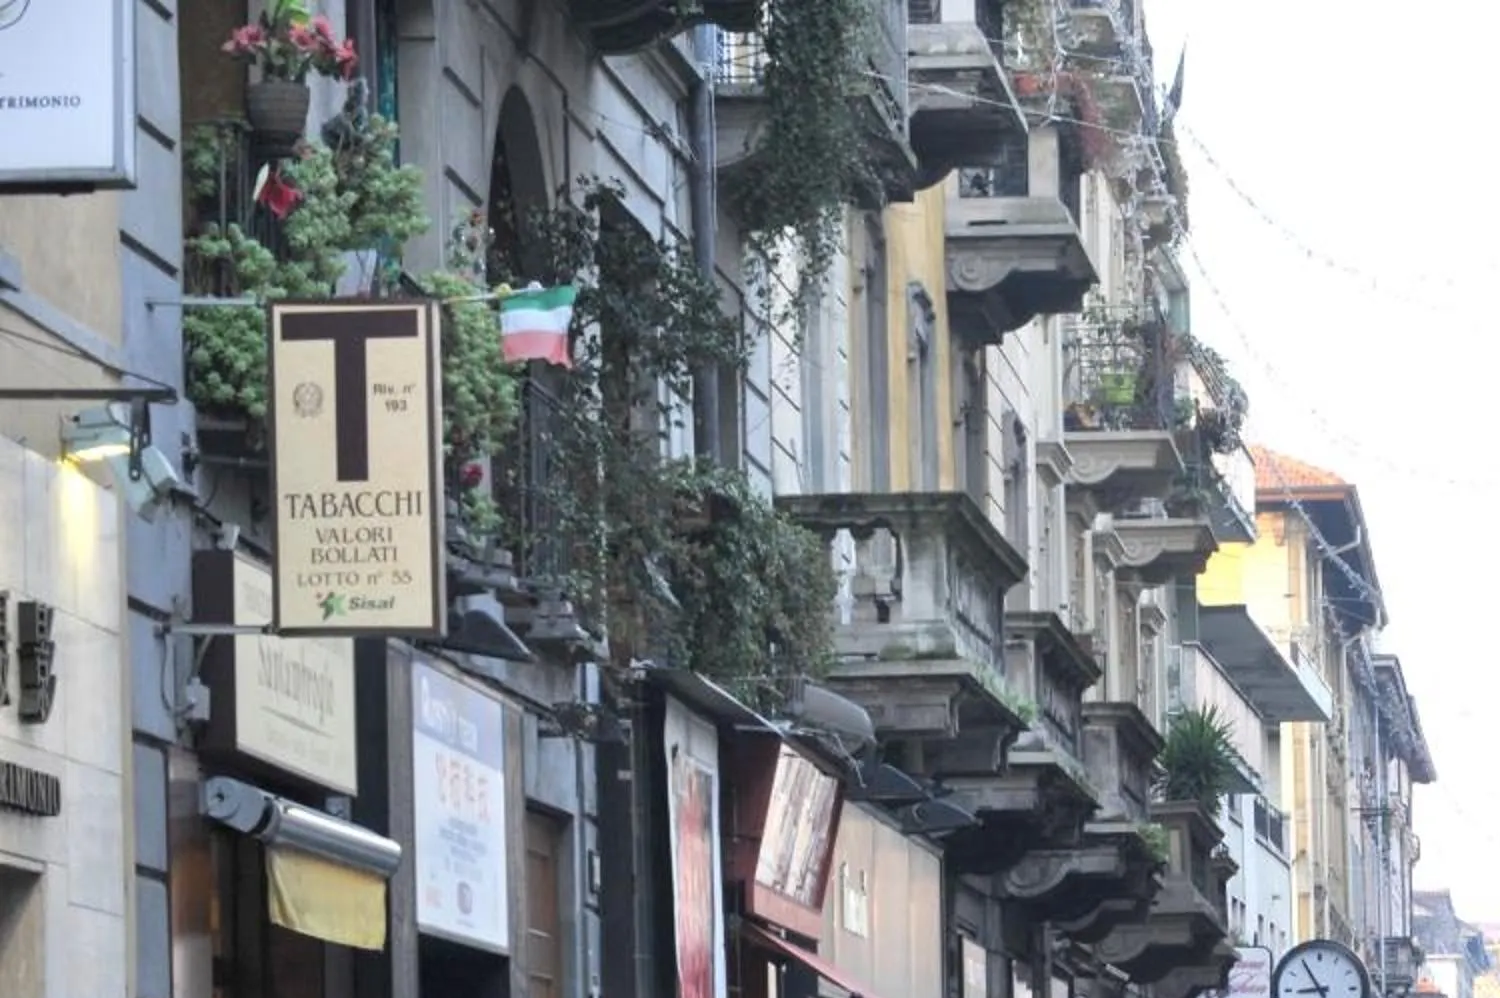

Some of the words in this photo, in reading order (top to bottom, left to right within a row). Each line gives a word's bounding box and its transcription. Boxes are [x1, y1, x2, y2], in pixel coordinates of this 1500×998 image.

[281, 309, 419, 482] T
[284, 490, 423, 519] TABACCHI
[315, 526, 394, 544] VALORI
[311, 546, 398, 565] BOLLATI
[296, 571, 360, 588] LOTTO
[348, 594, 396, 611] Sisal
